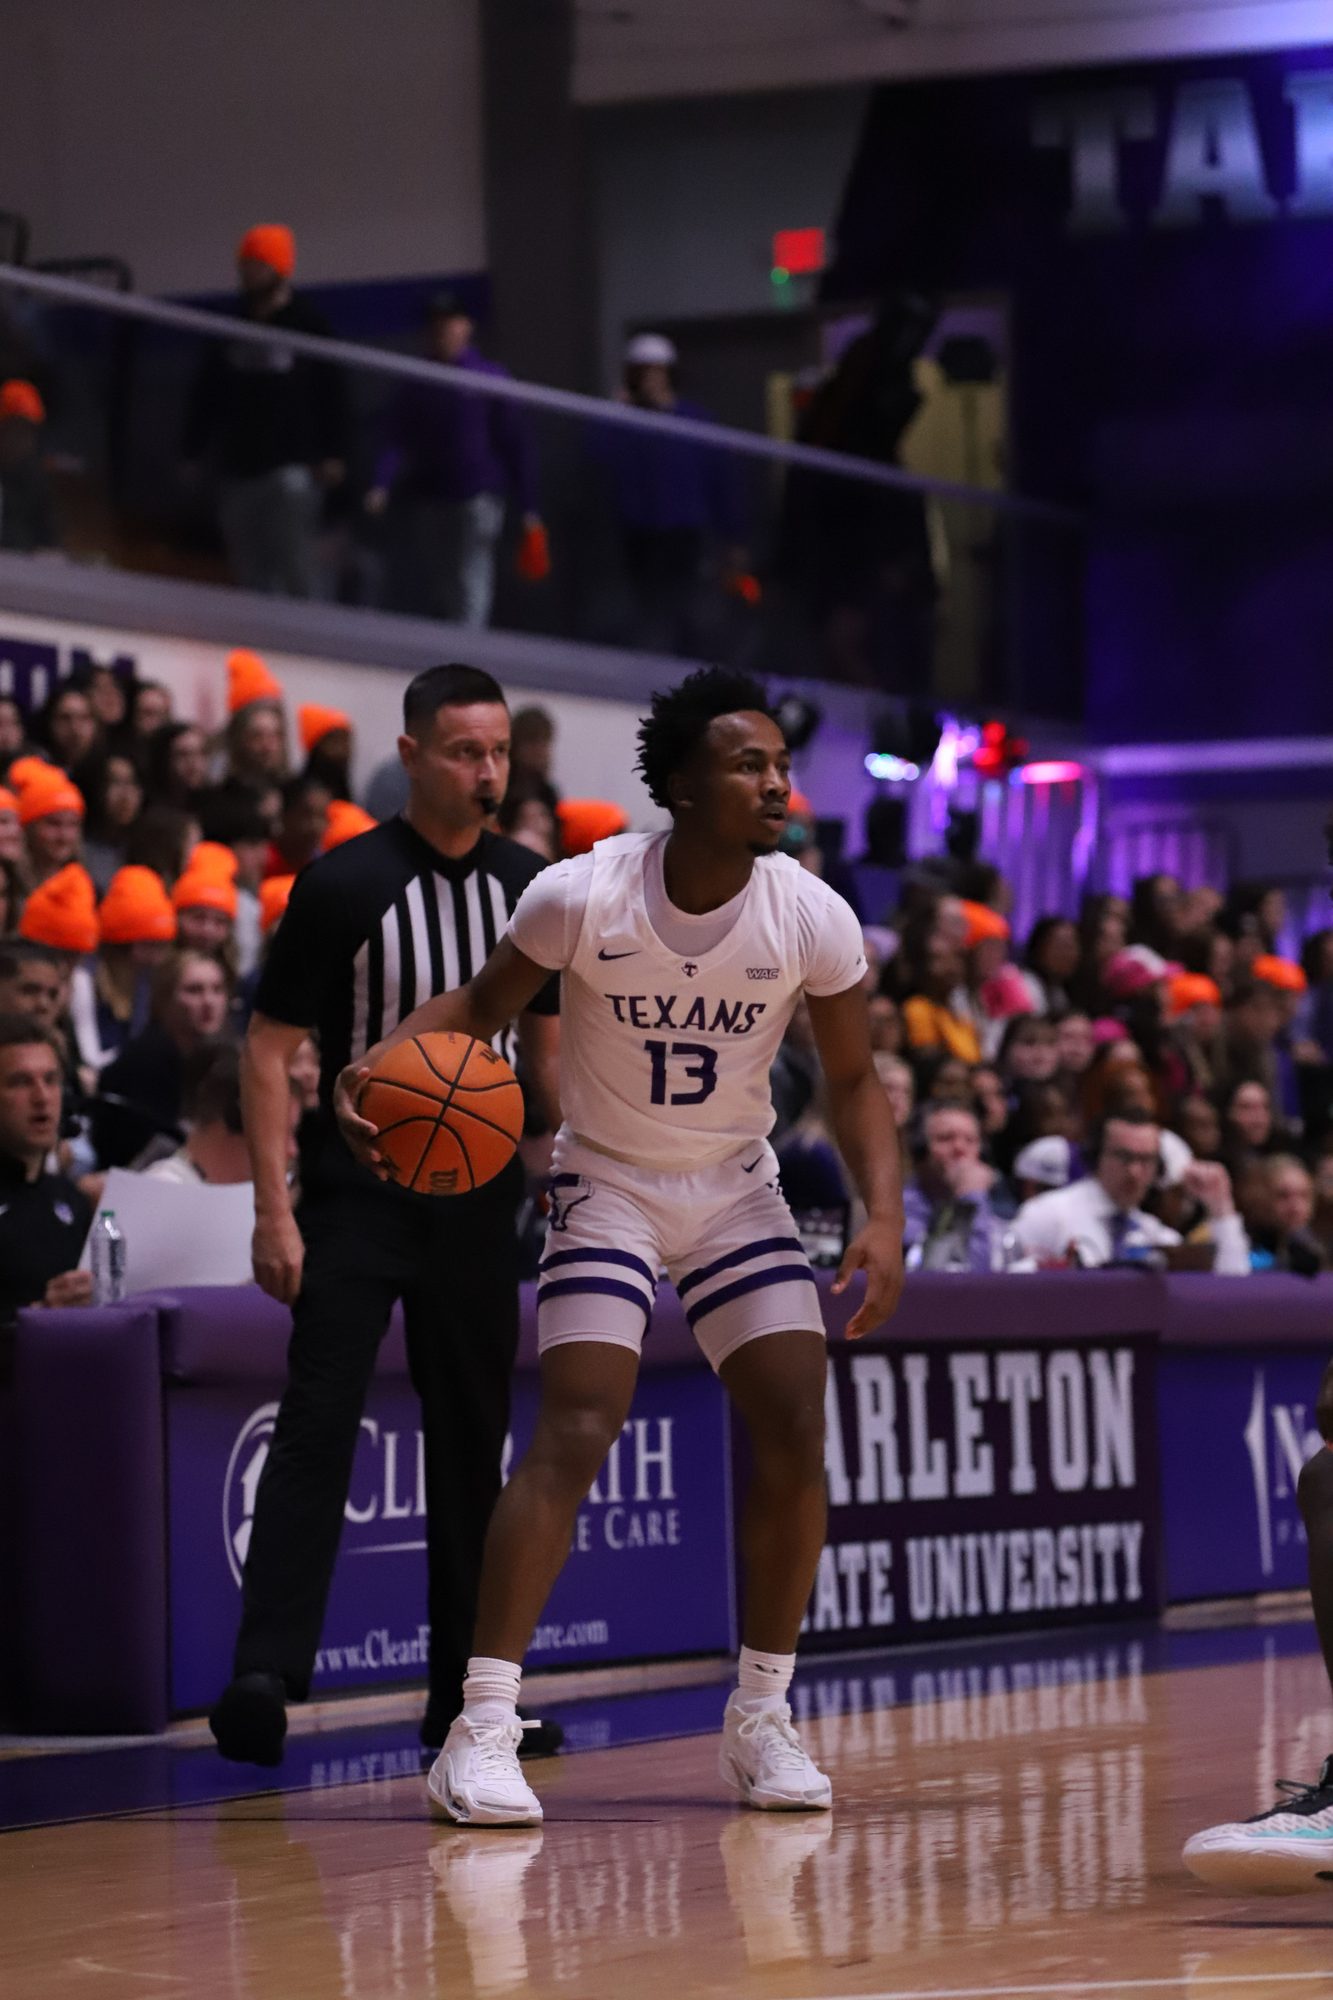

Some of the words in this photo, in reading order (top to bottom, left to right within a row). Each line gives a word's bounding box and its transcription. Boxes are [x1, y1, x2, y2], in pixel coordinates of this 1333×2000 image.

[746, 968, 779, 979] WAC
[604, 994, 767, 1034] TEXANS
[644, 1040, 718, 1106] 13
[824, 1348, 1137, 1506] RLETON
[800, 1540, 896, 1633] ATE
[905, 1520, 1144, 1622] UNIVERSITY
